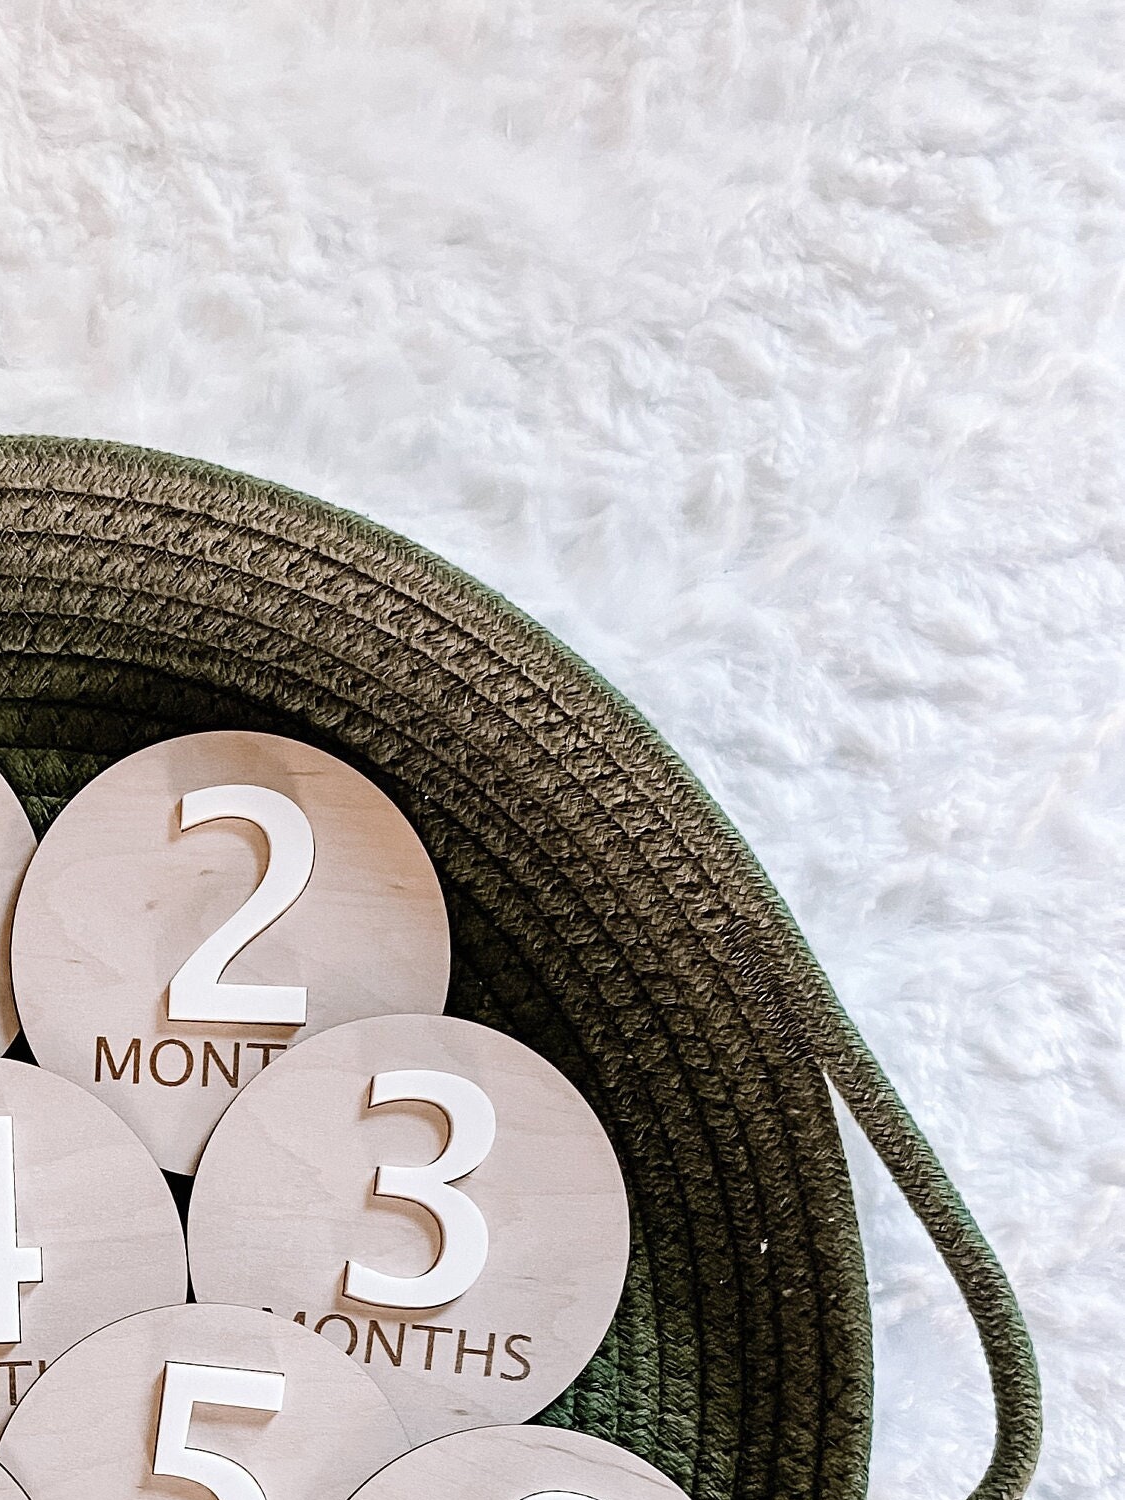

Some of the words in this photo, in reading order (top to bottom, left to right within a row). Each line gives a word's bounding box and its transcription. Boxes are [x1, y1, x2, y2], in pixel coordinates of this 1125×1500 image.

[168, 784, 315, 1026] 2
[342, 1069, 496, 1309] 3
[262, 1307, 531, 1380] ONTHS
